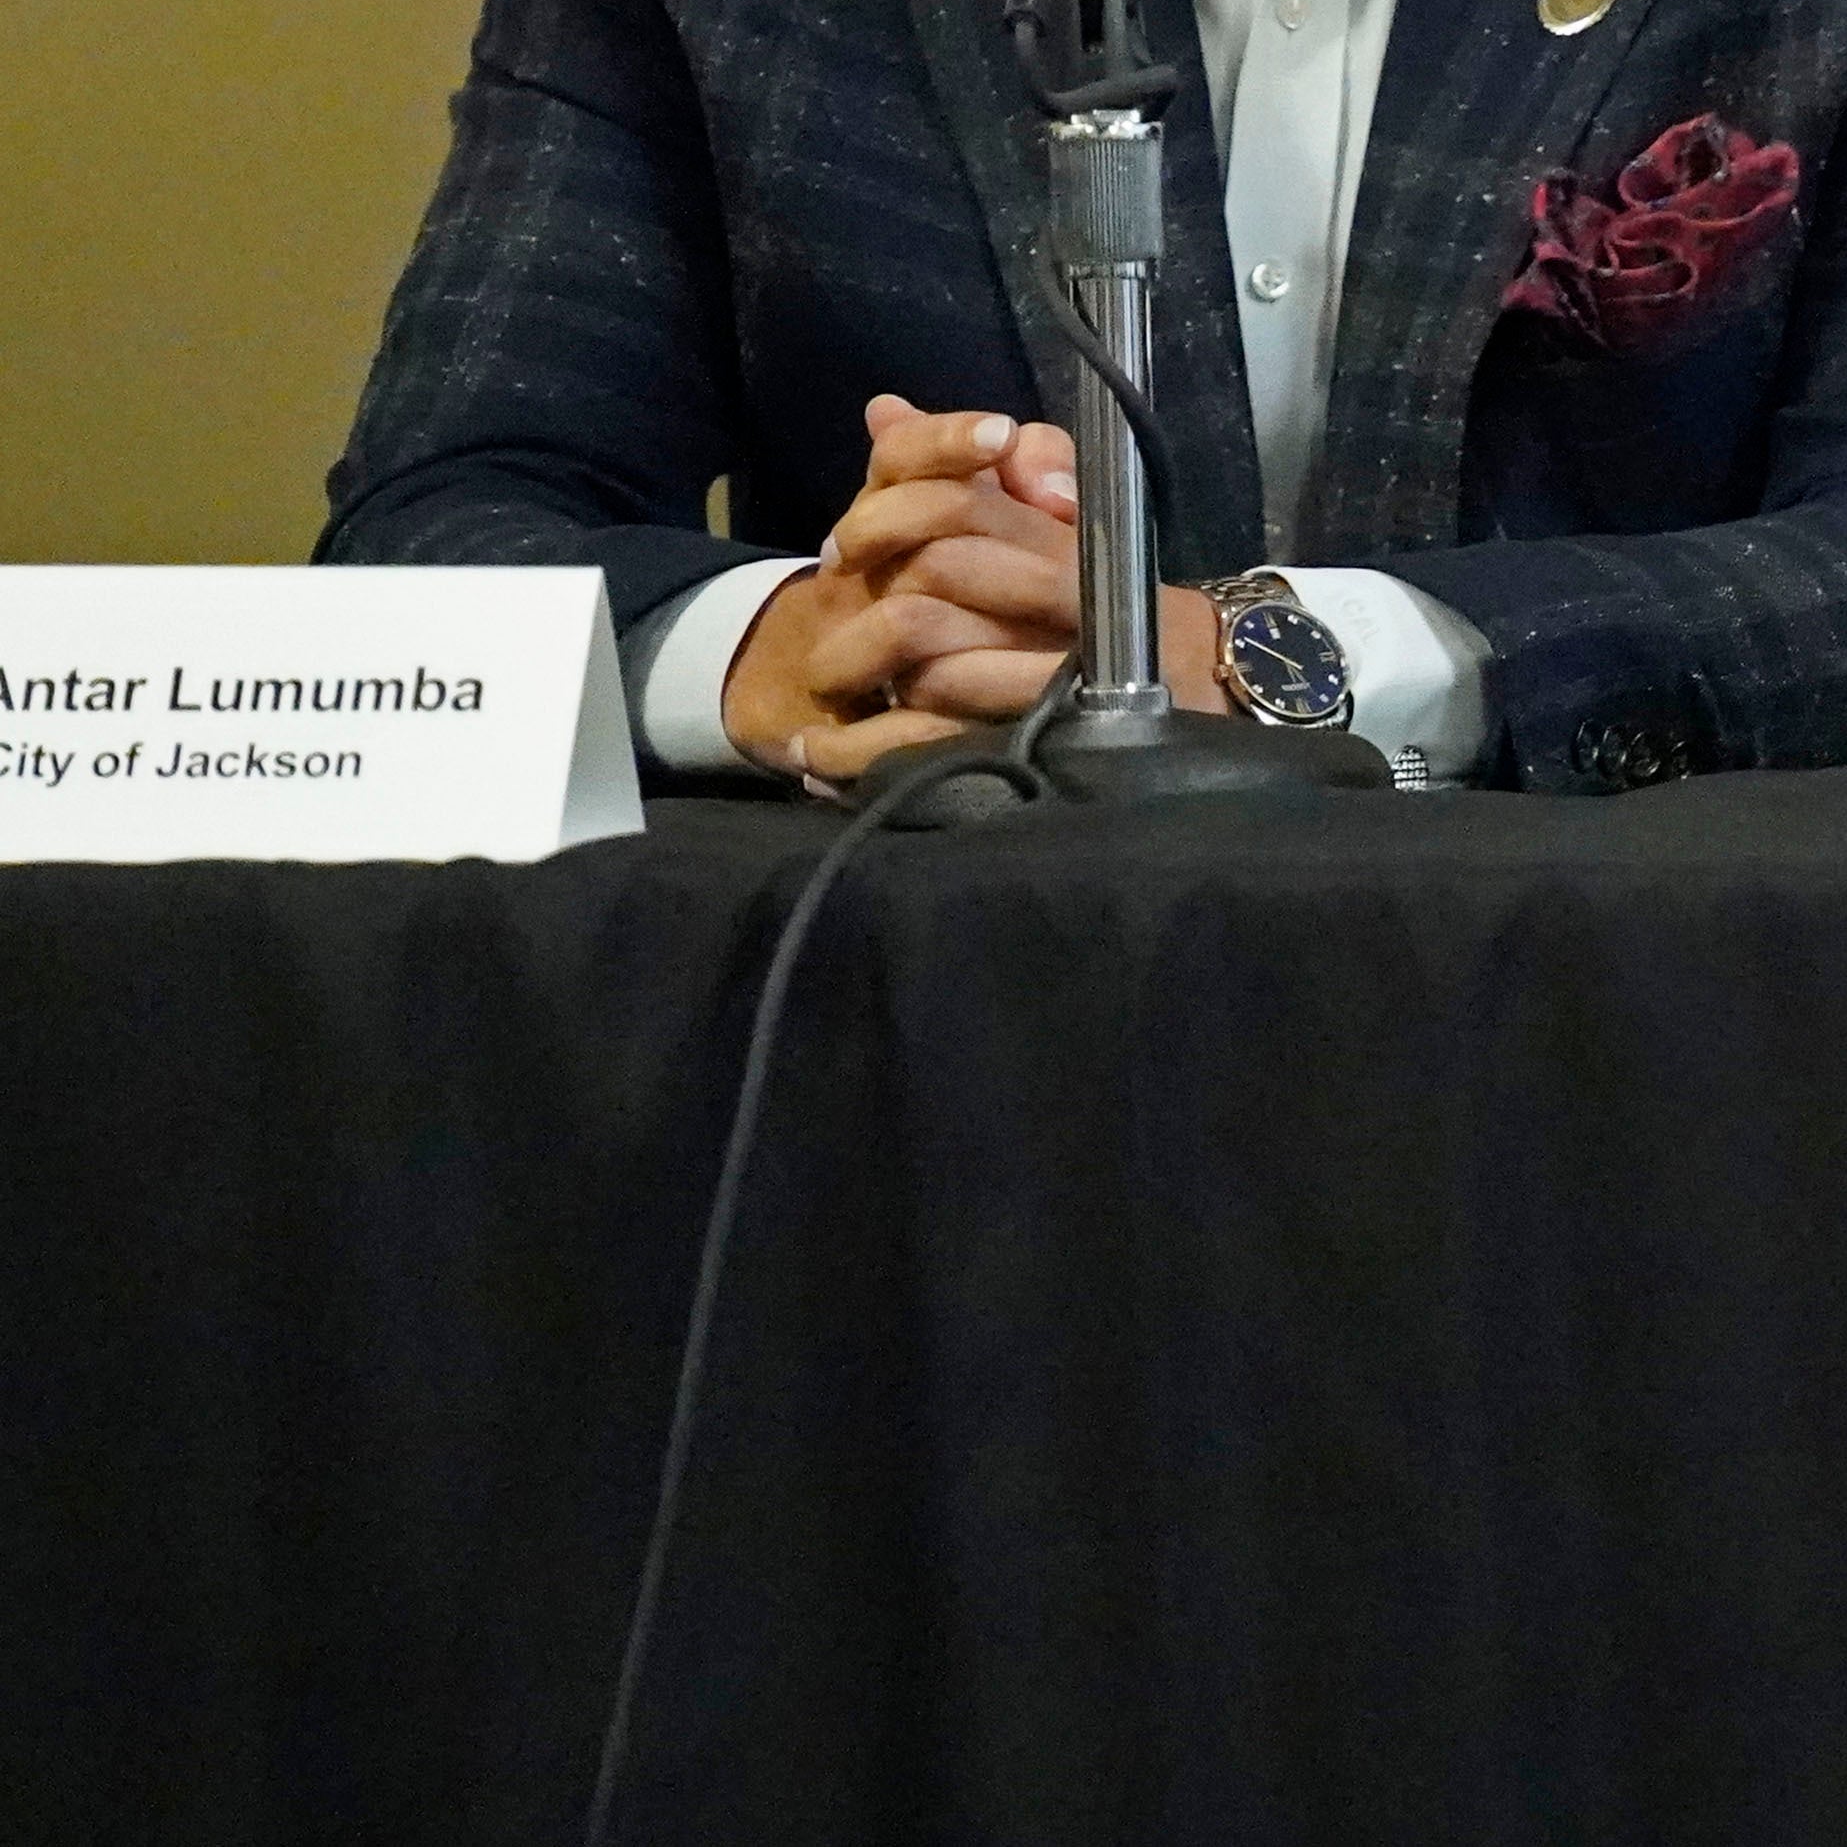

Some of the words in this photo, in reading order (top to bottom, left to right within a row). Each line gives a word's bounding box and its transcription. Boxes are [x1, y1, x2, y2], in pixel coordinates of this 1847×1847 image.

[168, 666, 485, 712] Lumumba
[92, 741, 144, 778] of
[155, 742, 363, 778] Jackson
